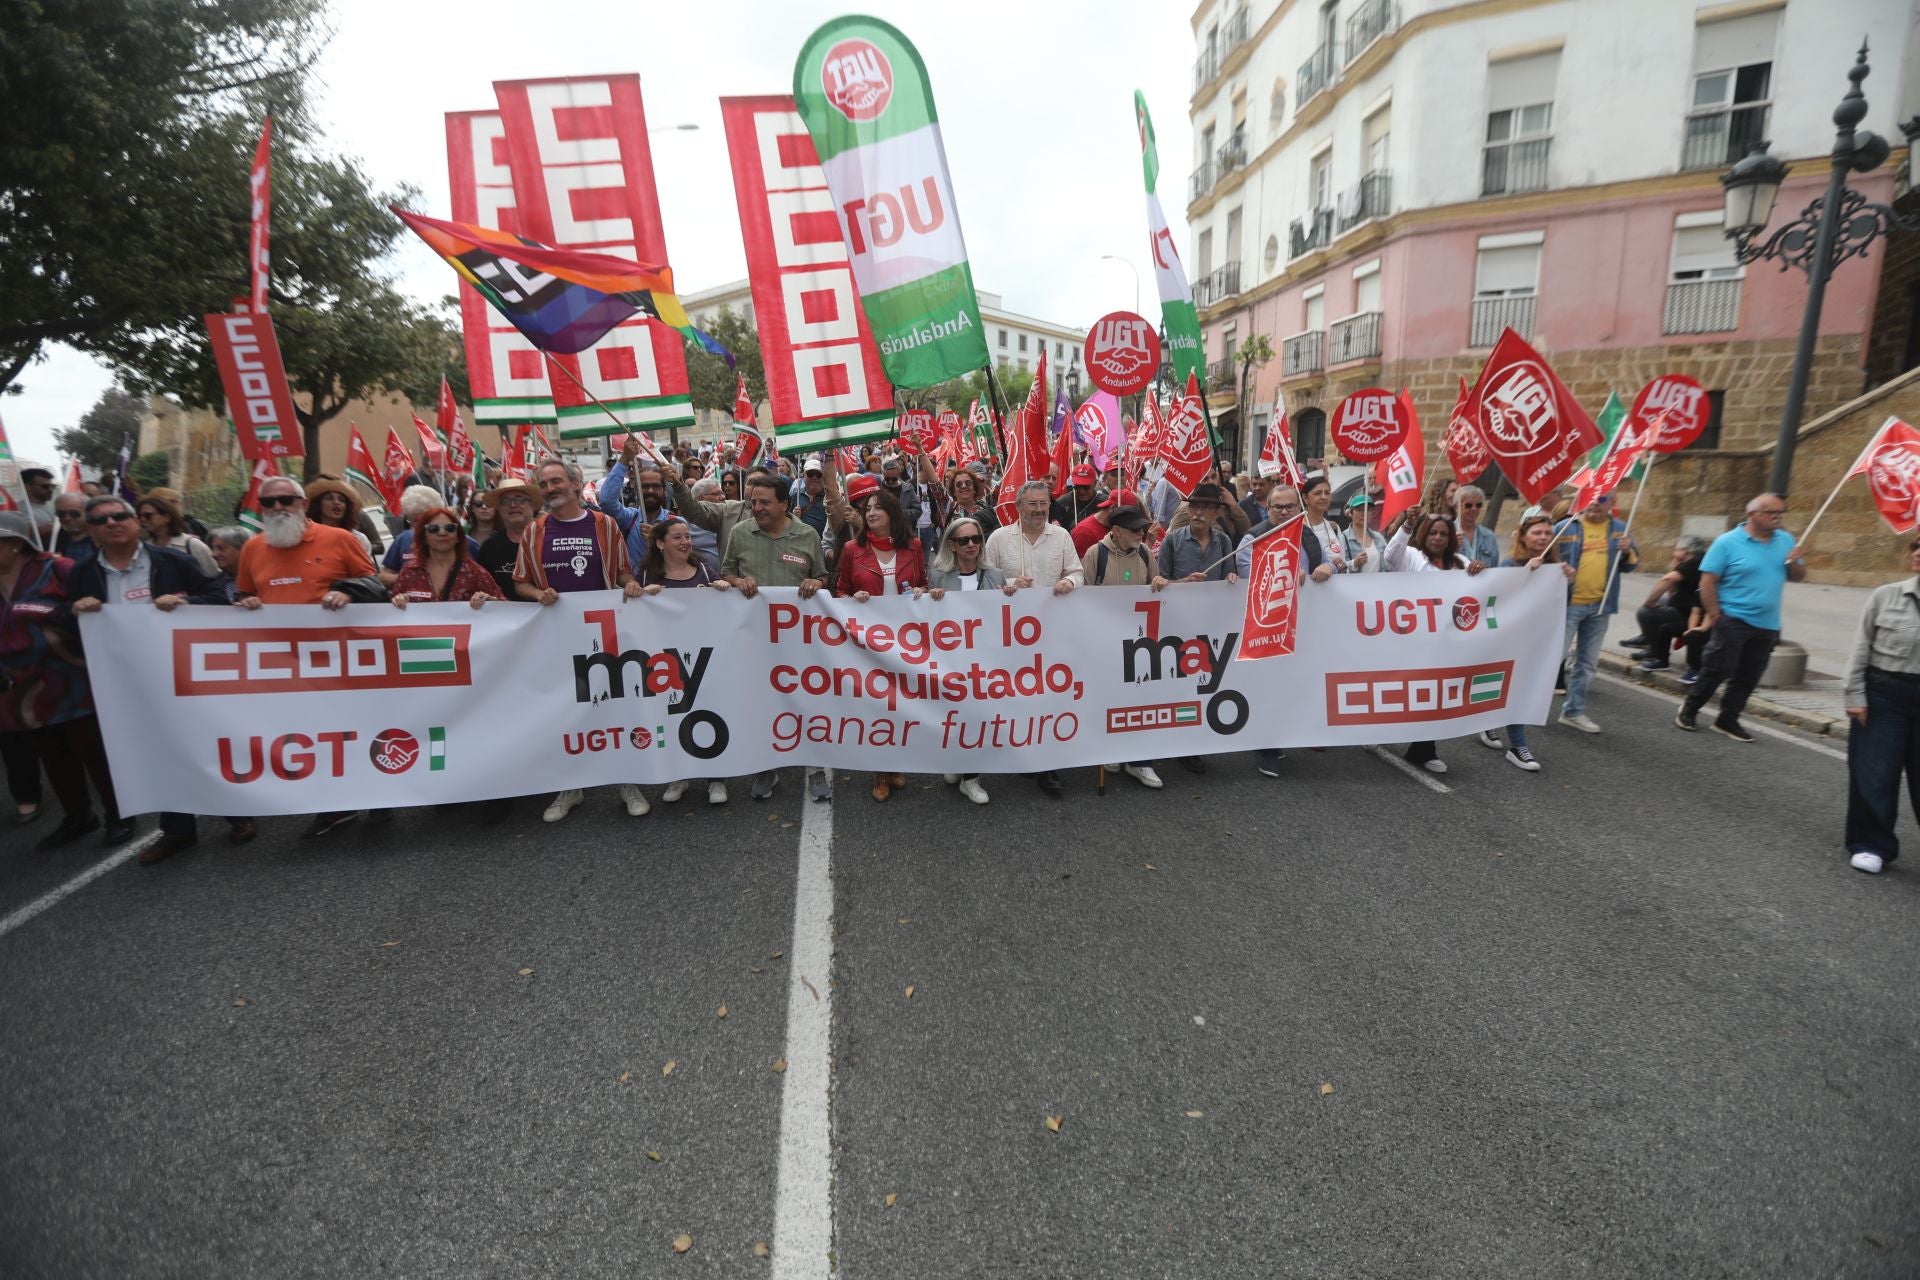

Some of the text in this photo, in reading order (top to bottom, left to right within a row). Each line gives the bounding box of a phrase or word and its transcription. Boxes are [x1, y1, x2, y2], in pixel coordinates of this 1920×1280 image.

[1094, 320, 1148, 350] UGT
[224, 316, 279, 424] CCOO
[1101, 375, 1141, 387] Andalucía
[1341, 396, 1397, 426] UGT
[1495, 367, 1556, 434] UGT
[1647, 379, 1702, 417] UGT
[901, 414, 931, 432] UGT
[1348, 443, 1389, 455] Andalucía
[553, 537, 583, 545] CCOO
[783, 554, 802, 563] CCOO
[1267, 549, 1295, 611] UGT
[768, 603, 1042, 665] Proteger lo
[1356, 597, 1443, 637] UGT
[190, 638, 387, 682] CCOO
[769, 653, 1084, 711] conquistado,
[1337, 676, 1466, 715] CCOO
[771, 710, 1080, 753] ganar futuro
[1111, 707, 1172, 729] CCOO
[217, 730, 358, 784] UGT
[563, 727, 625, 755] UGT
